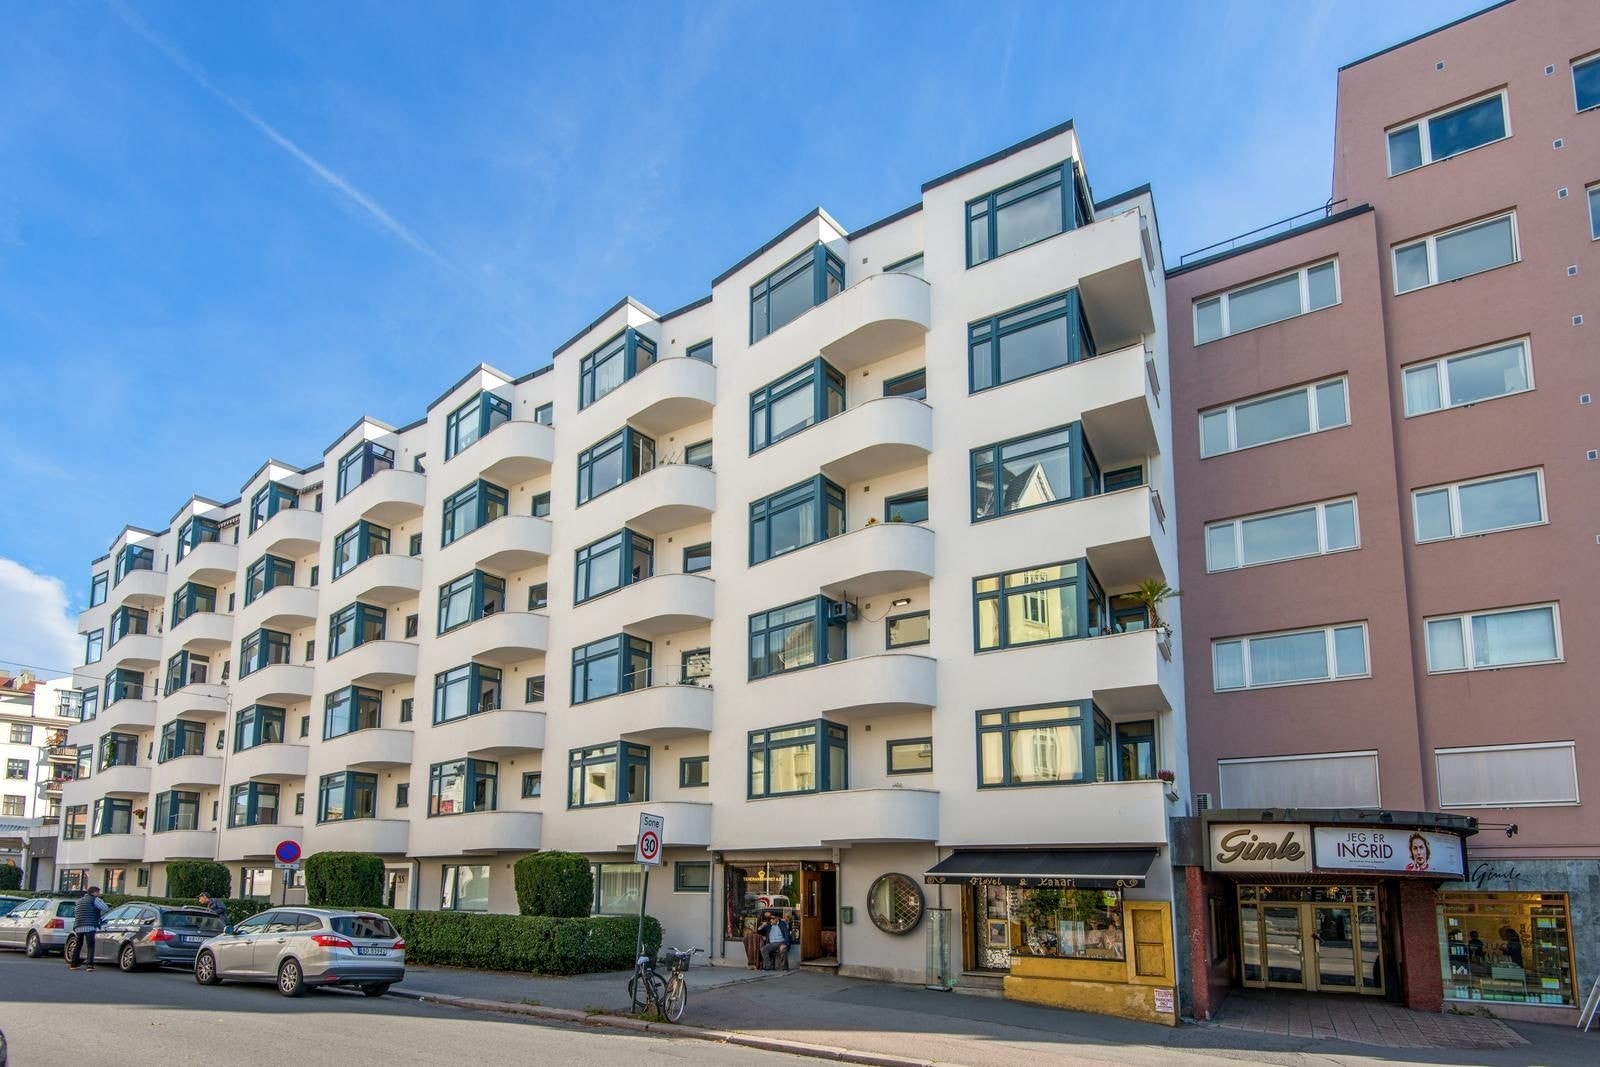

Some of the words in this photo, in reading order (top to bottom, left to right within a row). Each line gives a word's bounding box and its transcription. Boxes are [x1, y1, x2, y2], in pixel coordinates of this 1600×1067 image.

[644, 816, 660, 828] Sone
[643, 837, 656, 853] 30
[1346, 832, 1367, 843] JEG
[1373, 833, 1386, 843] ER
[1216, 828, 1306, 864] Gimle
[1337, 842, 1393, 859] INGRID
[1019, 877, 1027, 886] &
[1471, 862, 1532, 889] Gimle
